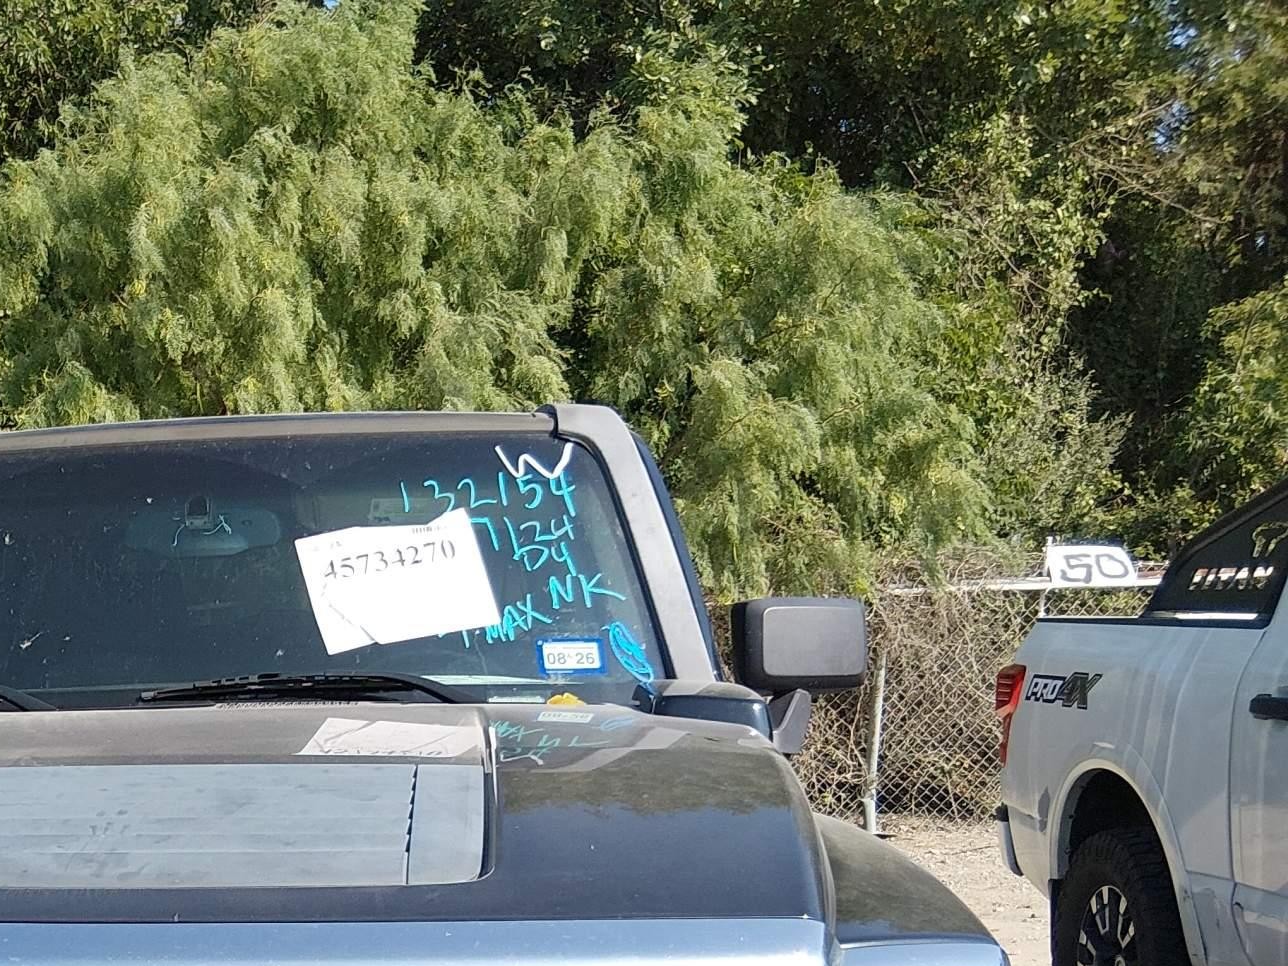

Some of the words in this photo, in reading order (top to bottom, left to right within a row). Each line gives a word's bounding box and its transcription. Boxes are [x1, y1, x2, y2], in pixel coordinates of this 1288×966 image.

[1060, 553, 1130, 584] 50
[1188, 566, 1275, 591] TITAN
[547, 652, 567, 665] 08
[576, 652, 596, 665] 26
